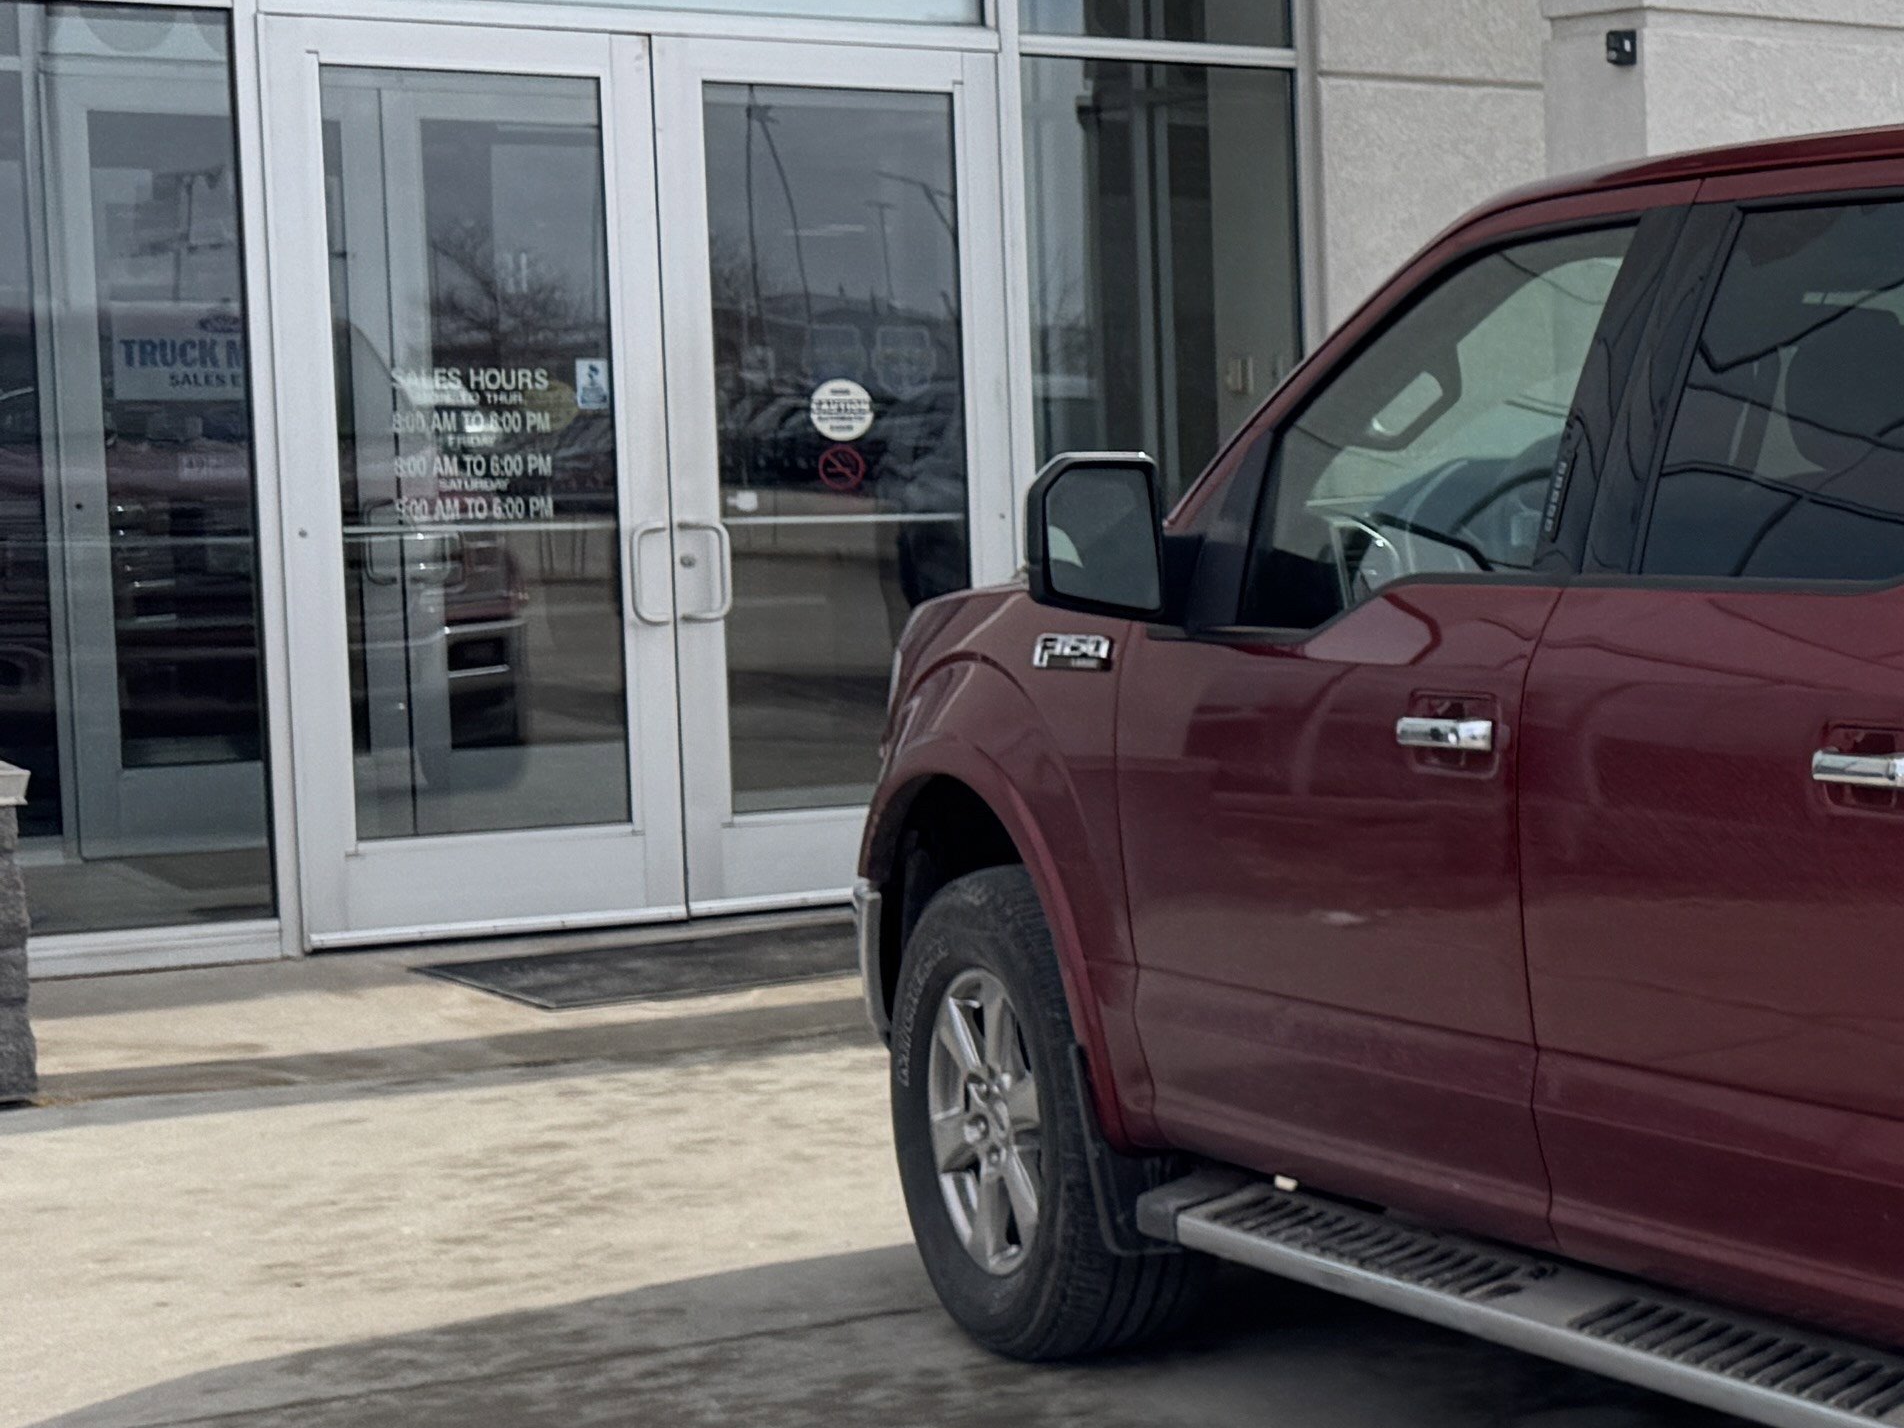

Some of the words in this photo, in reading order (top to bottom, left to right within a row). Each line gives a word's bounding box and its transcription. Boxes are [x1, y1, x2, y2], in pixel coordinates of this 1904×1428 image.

[120, 338, 220, 368] TRUCK
[168, 373, 226, 389] SALES
[469, 367, 550, 390] HOURS
[431, 411, 456, 433] AM
[463, 411, 485, 432] TO
[526, 410, 551, 433] PM
[432, 455, 458, 477] AM
[462, 454, 486, 477] TO
[527, 453, 552, 477] PM
[438, 478, 510, 492] SATURDAY
[434, 497, 460, 520] AM
[465, 496, 487, 519] TO
[529, 496, 554, 519] PM
